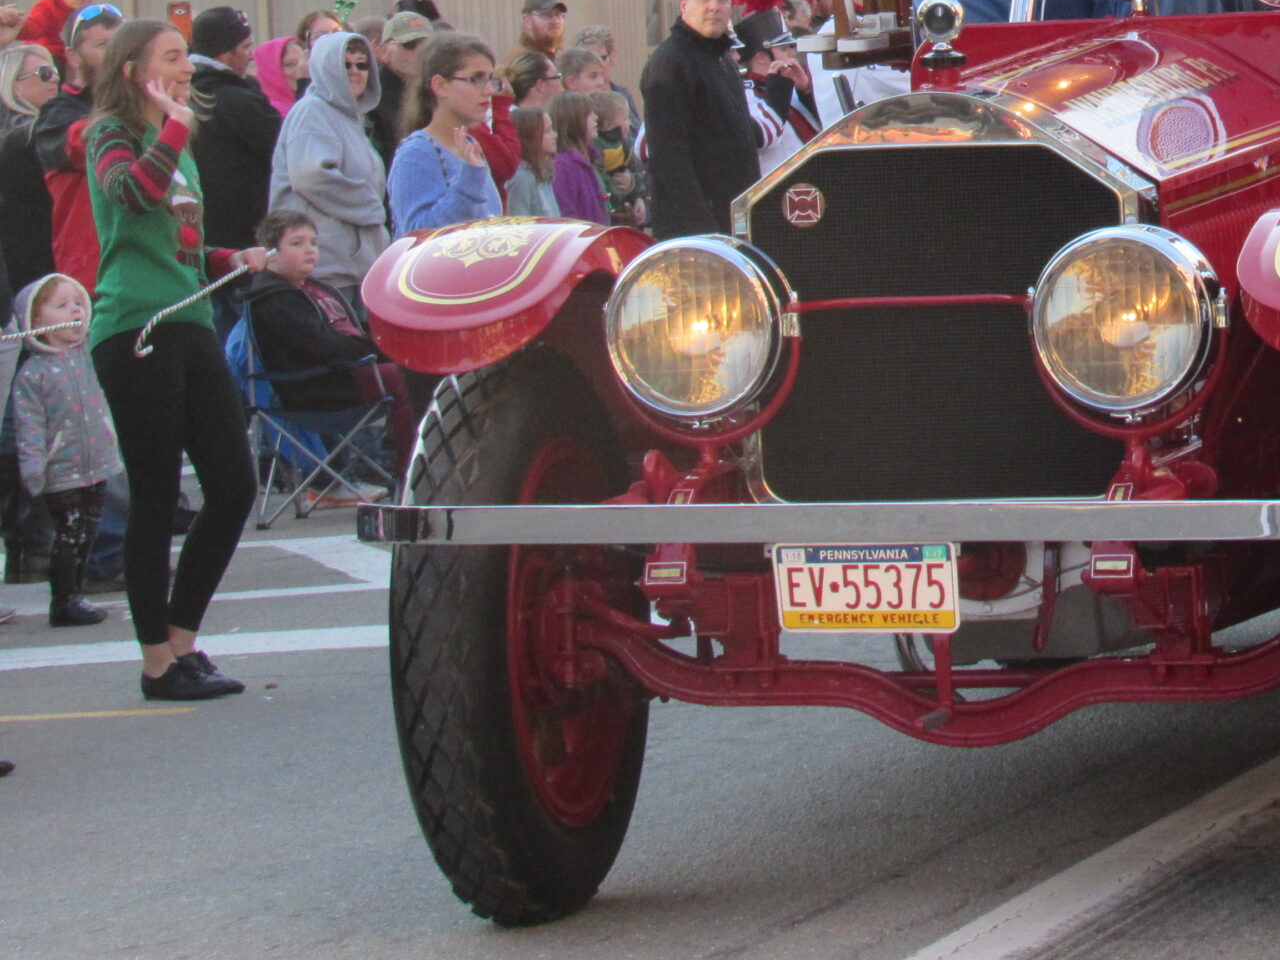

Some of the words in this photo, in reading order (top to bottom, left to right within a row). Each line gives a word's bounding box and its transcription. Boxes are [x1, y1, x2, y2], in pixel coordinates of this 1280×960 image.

[819, 548, 909, 561] PENNSYLVANIA
[800, 613, 875, 625] EMERGENCY
[882, 613, 940, 625] VEHICLE
